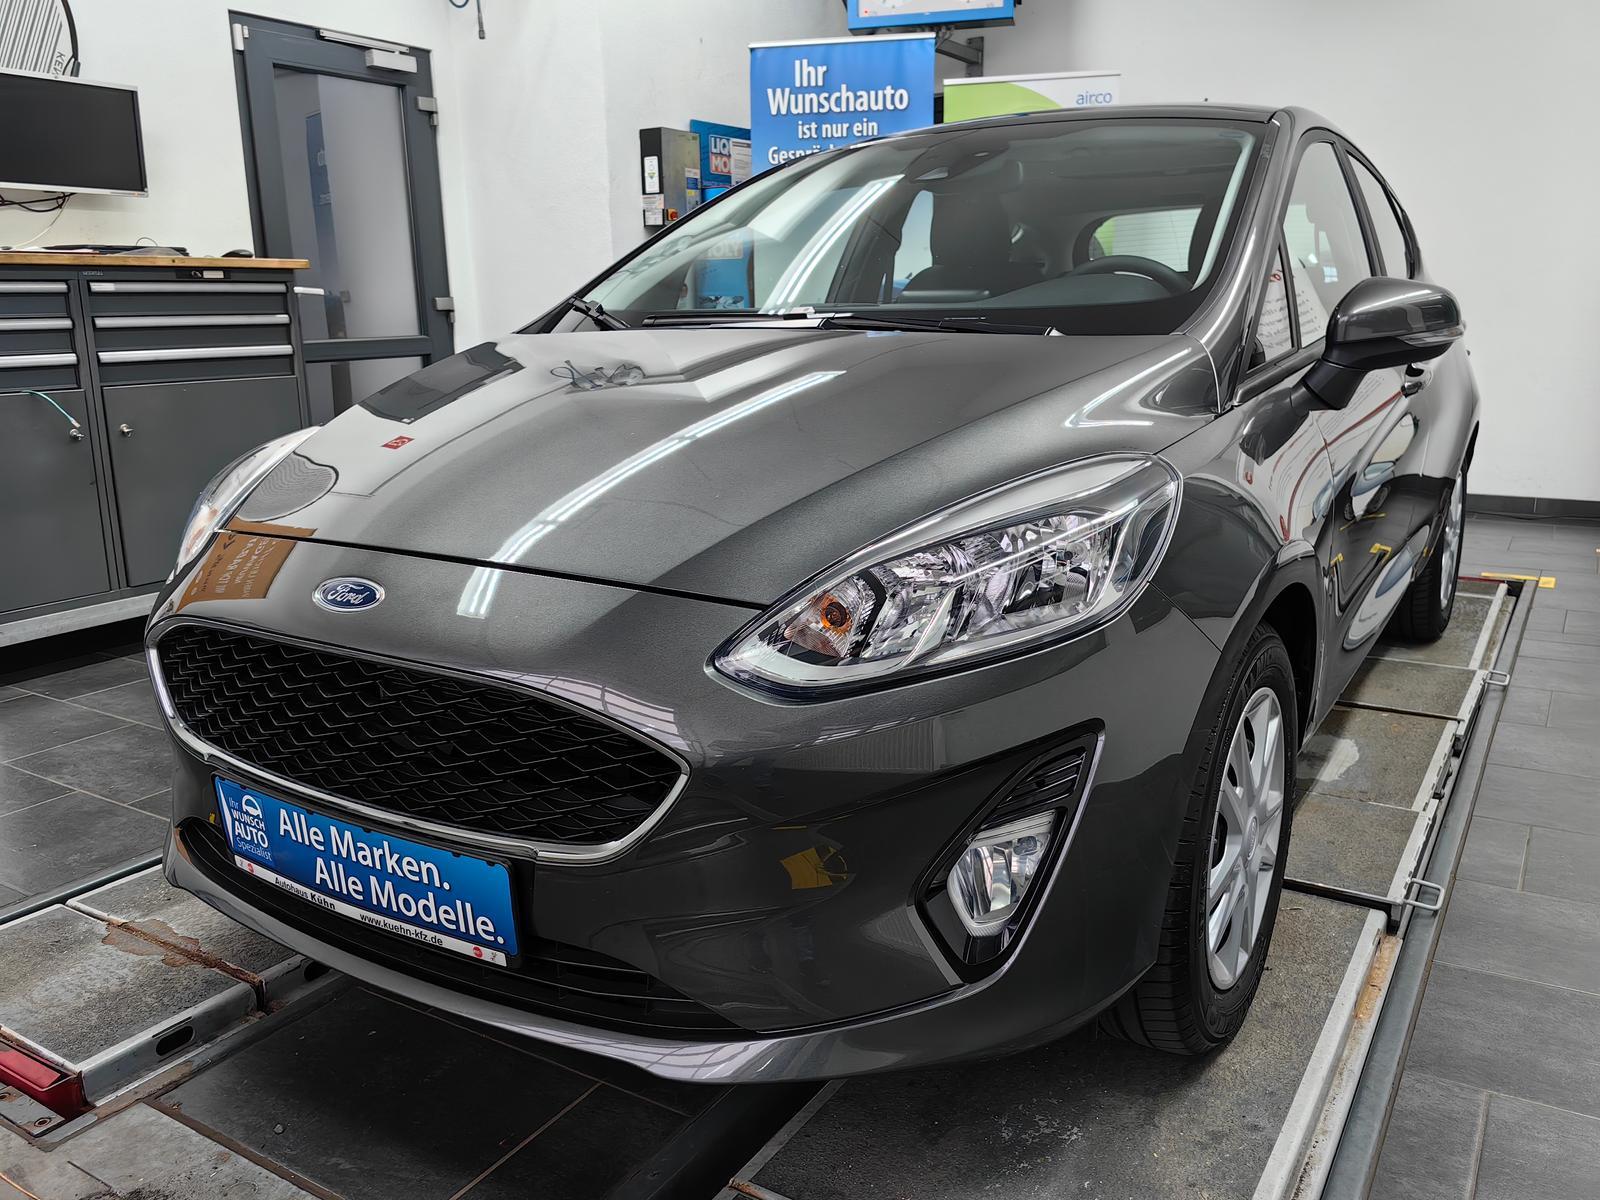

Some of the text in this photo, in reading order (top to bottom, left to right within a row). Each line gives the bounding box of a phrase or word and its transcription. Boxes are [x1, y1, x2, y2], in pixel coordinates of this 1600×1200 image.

[794, 58, 827, 88] Ihr
[766, 83, 909, 116] Wunschauto
[1075, 90, 1113, 105] airco
[797, 117, 878, 139] ist nur ein
[711, 136, 731, 157] LIQ
[711, 154, 731, 173] MO
[327, 583, 370, 605] Ford
[228, 797, 239, 810] Ihr
[231, 809, 266, 831] WUNSCH
[234, 820, 269, 849] AUTO
[236, 837, 273, 861] Spezialist
[279, 808, 451, 891] Alle Marken.
[274, 877, 337, 911] Autohaus Kühn
[315, 856, 505, 944] Alle Modelle.
[359, 912, 443, 946] www.kuehn-kfz.de
